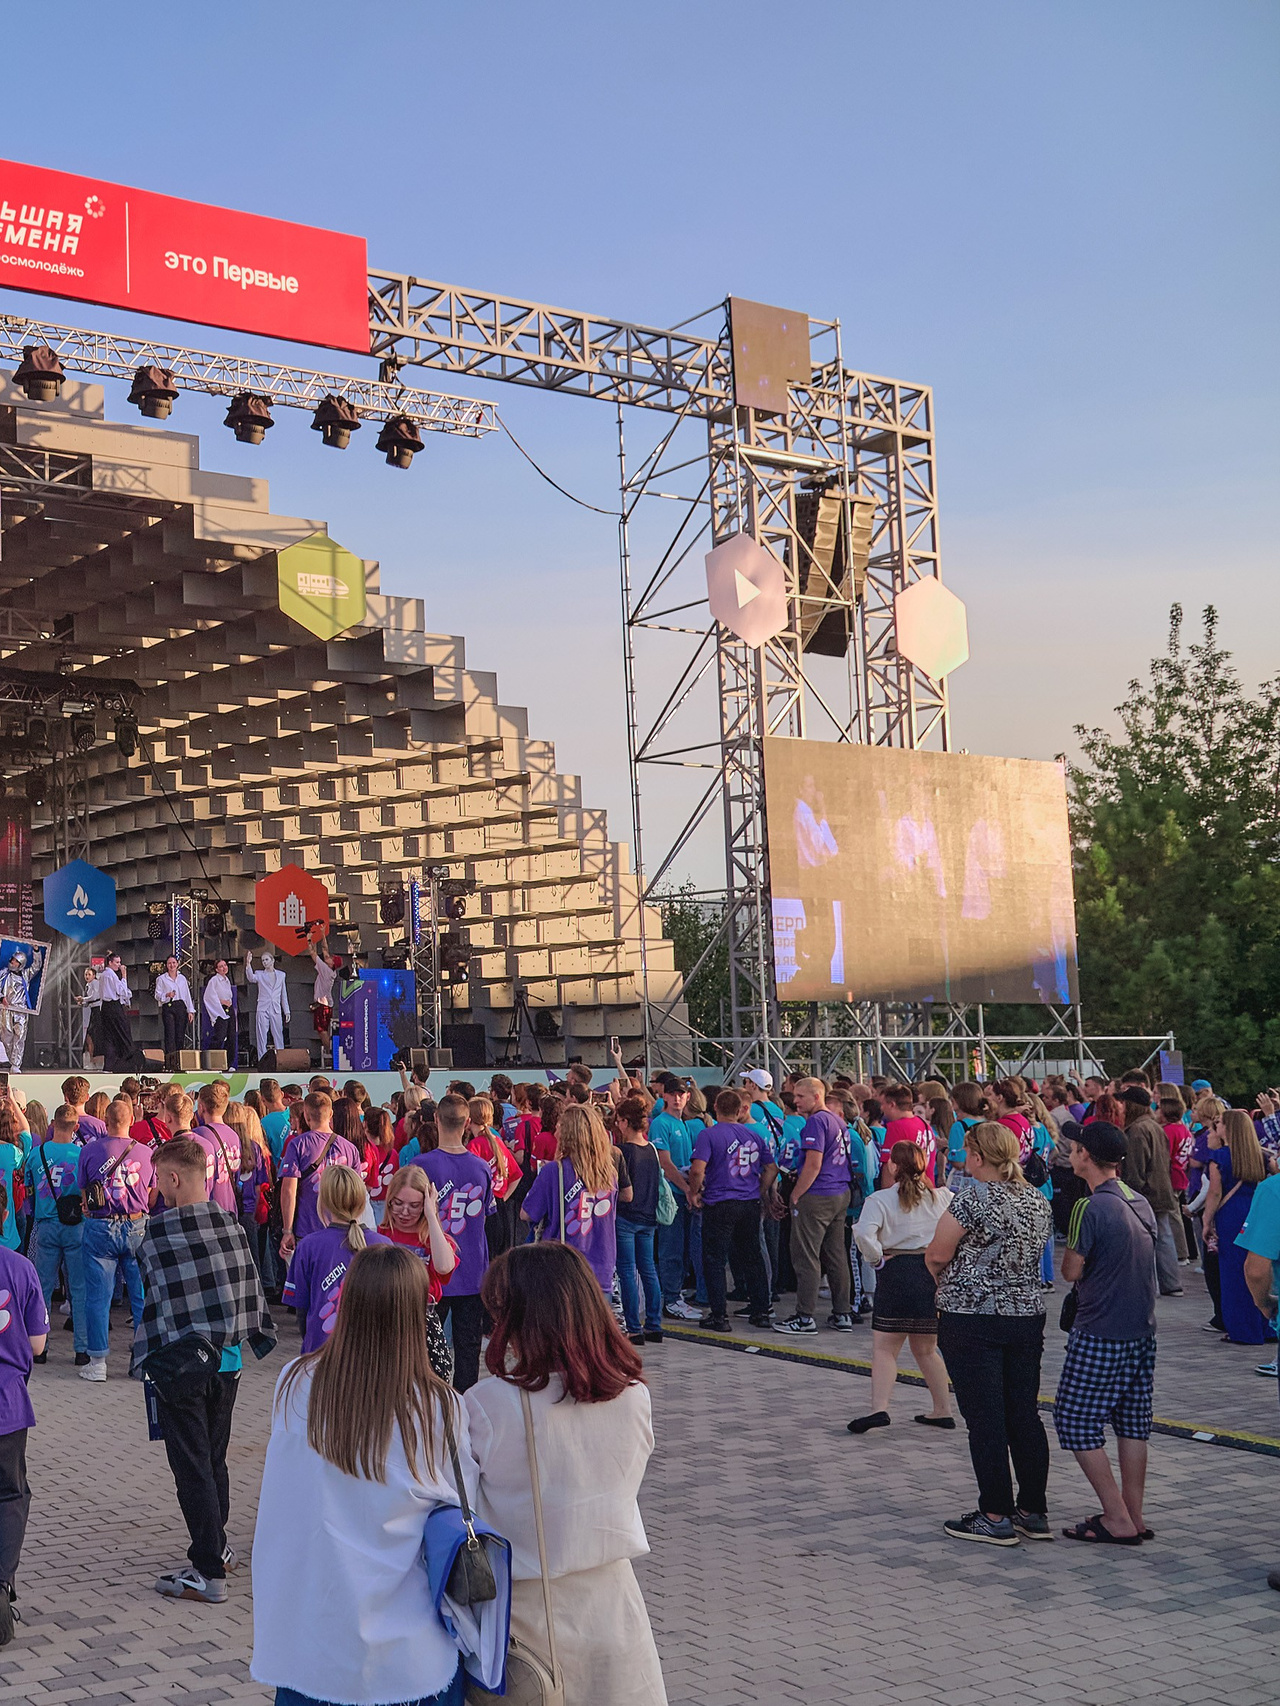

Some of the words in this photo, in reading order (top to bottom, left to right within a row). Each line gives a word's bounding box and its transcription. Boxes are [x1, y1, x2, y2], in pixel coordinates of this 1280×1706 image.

[164, 251, 207, 275] это
[213, 256, 299, 293] Первые
[739, 1147, 751, 1166] 5
[784, 1143, 794, 1159] 5
[51, 1167, 64, 1188] 5
[564, 1178, 584, 1203] СЕЗОН
[450, 1192, 469, 1219] 5
[580, 1191, 595, 1219] 5
[321, 1262, 347, 1292] СЕЗОН
